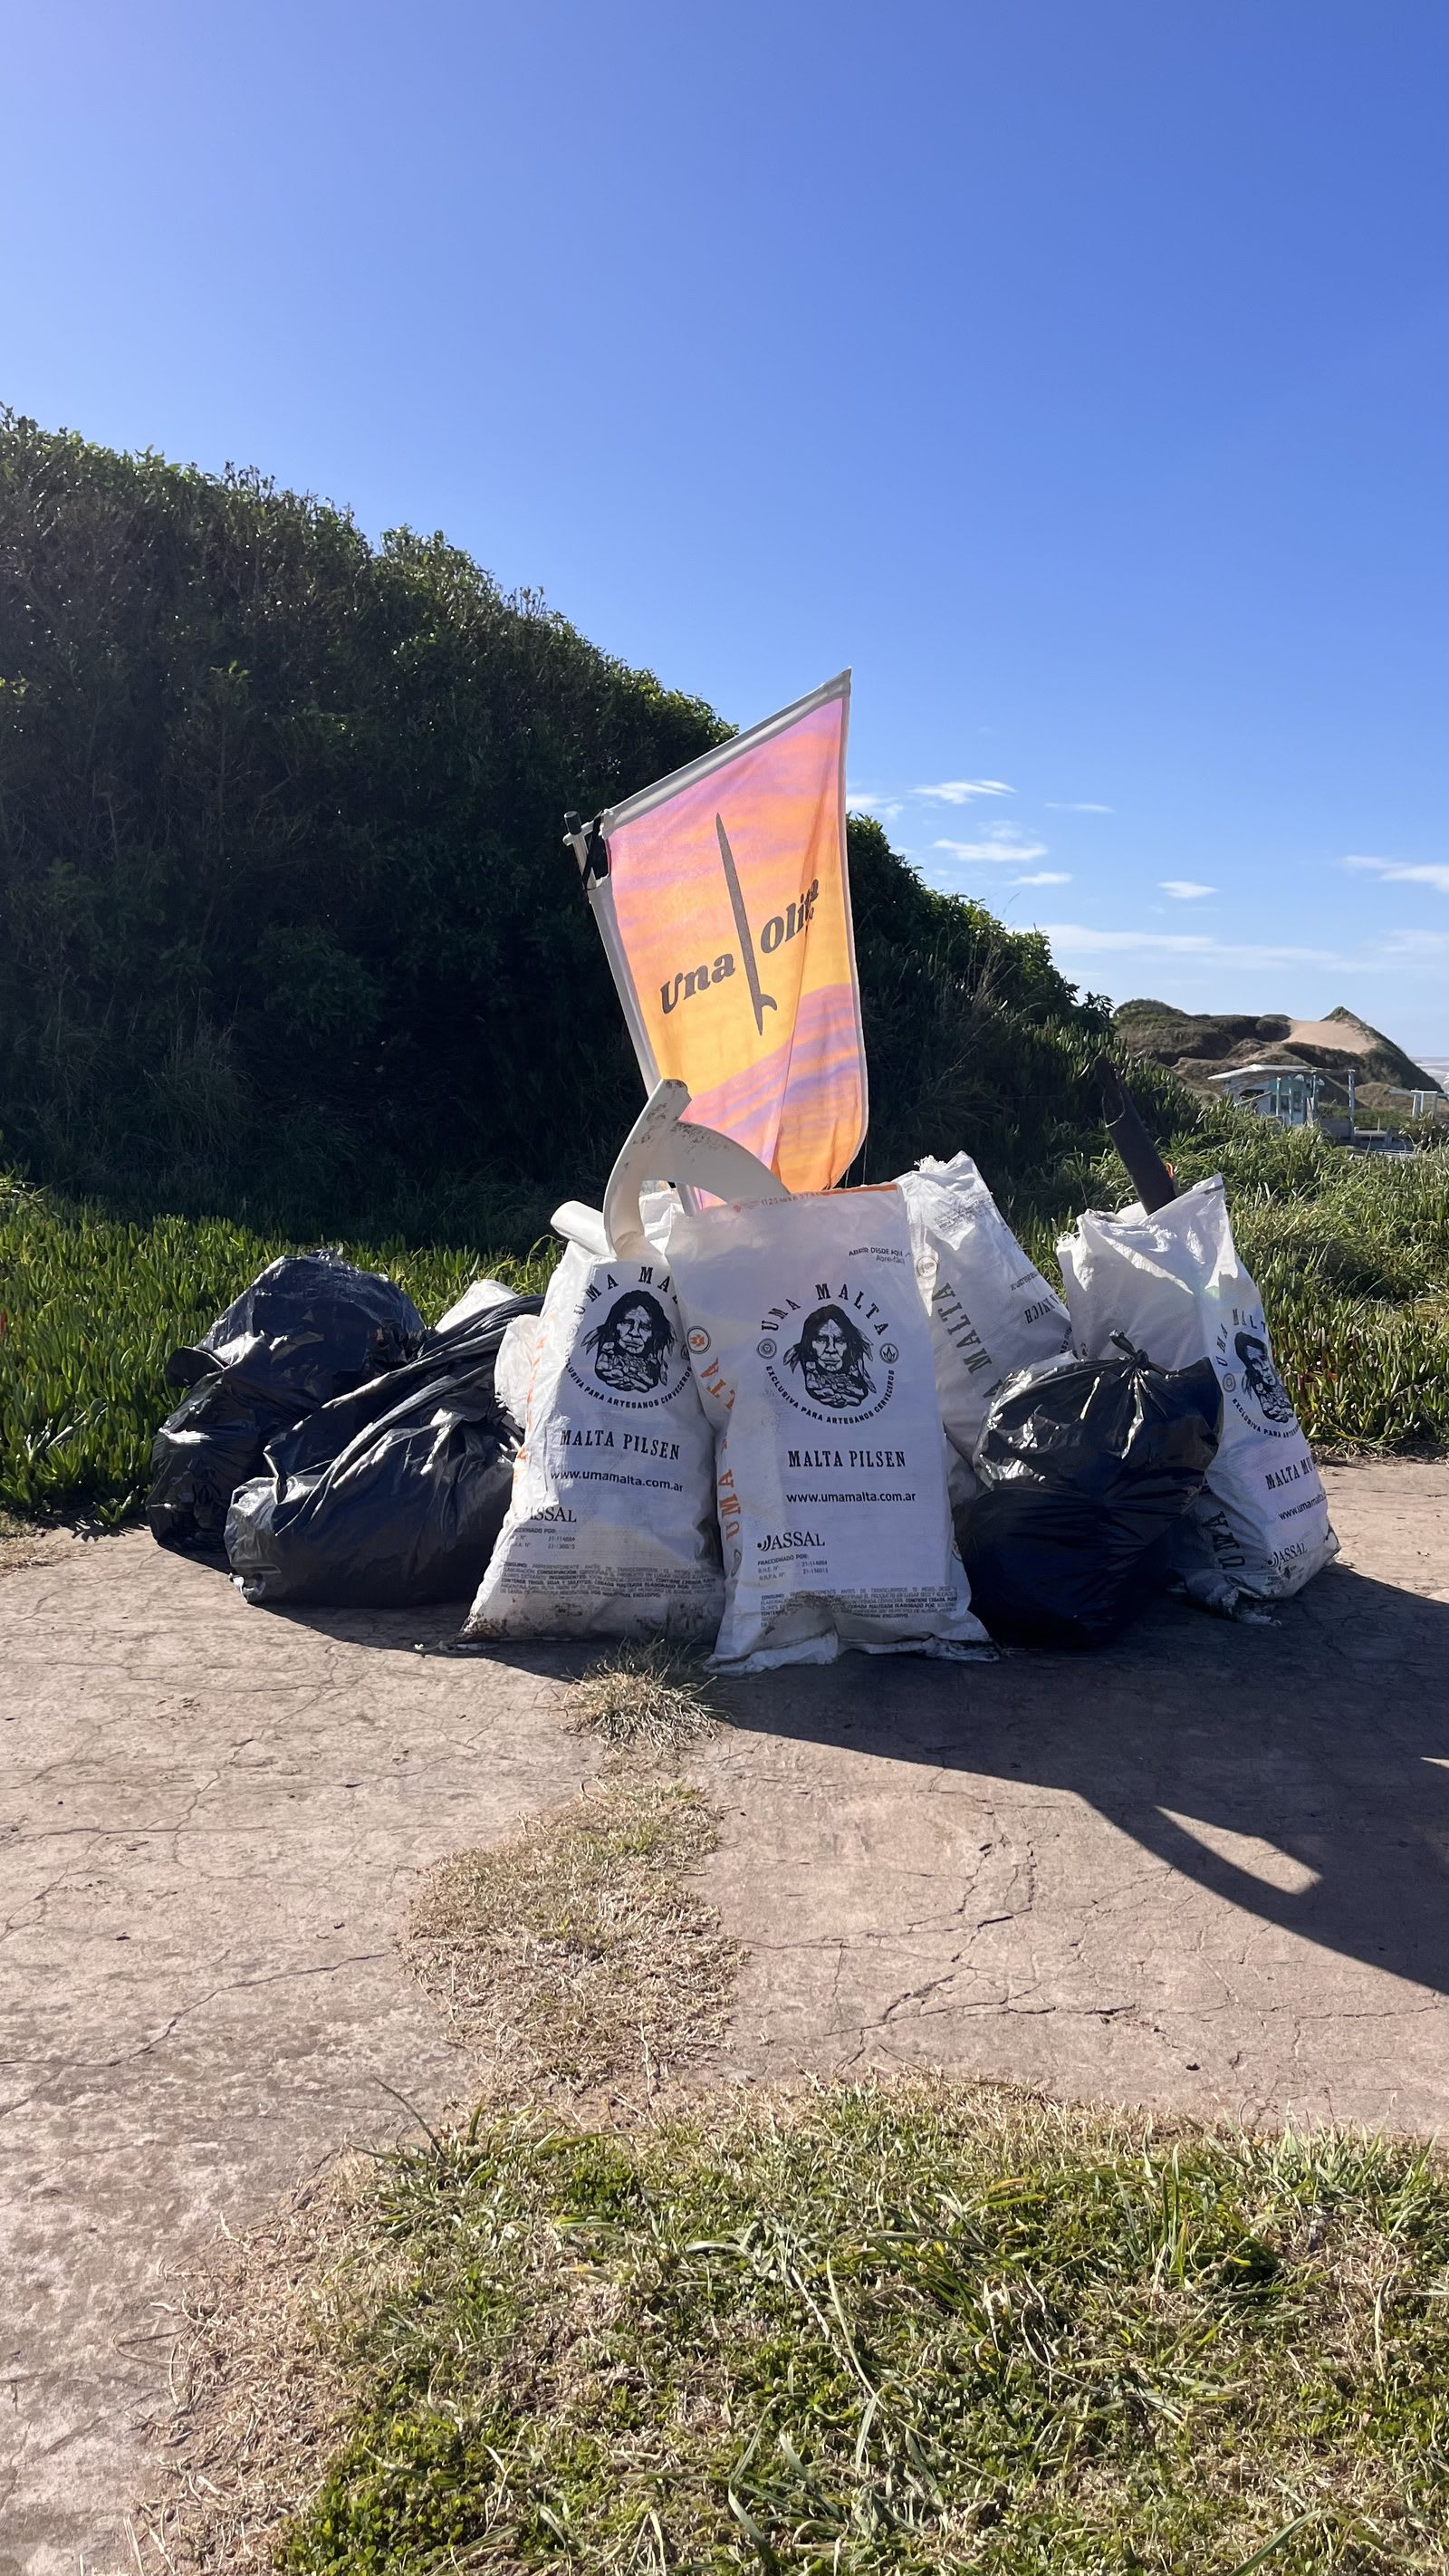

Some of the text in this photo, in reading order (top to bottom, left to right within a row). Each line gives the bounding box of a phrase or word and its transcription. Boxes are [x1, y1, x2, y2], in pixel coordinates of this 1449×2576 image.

[660, 954, 735, 1014] Una
[574, 1274, 619, 1315] UMA
[762, 1283, 889, 1335] UMA MALTA
[932, 1282, 993, 1375] MALTA
[1216, 1322, 1228, 1366] UMA
[584, 1387, 605, 1401] PARA
[607, 1397, 659, 1409] ARTESANOS
[765, 1365, 800, 1408] EXCLUSIVA
[801, 1407, 824, 1422] PARA
[826, 1410, 874, 1425] ARTESANOS
[1232, 1398, 1262, 1432] EXCLUSIVA
[560, 1429, 680, 1461] MALTA PILSEN
[788, 1450, 907, 1468] MALTA PILSEN
[550, 1469, 683, 1493] www.umamalta.com.ar
[1265, 1464, 1300, 1491] MALTA
[718, 1468, 742, 1540] UMA
[786, 1492, 916, 1504] www.umamalta.com.ar
